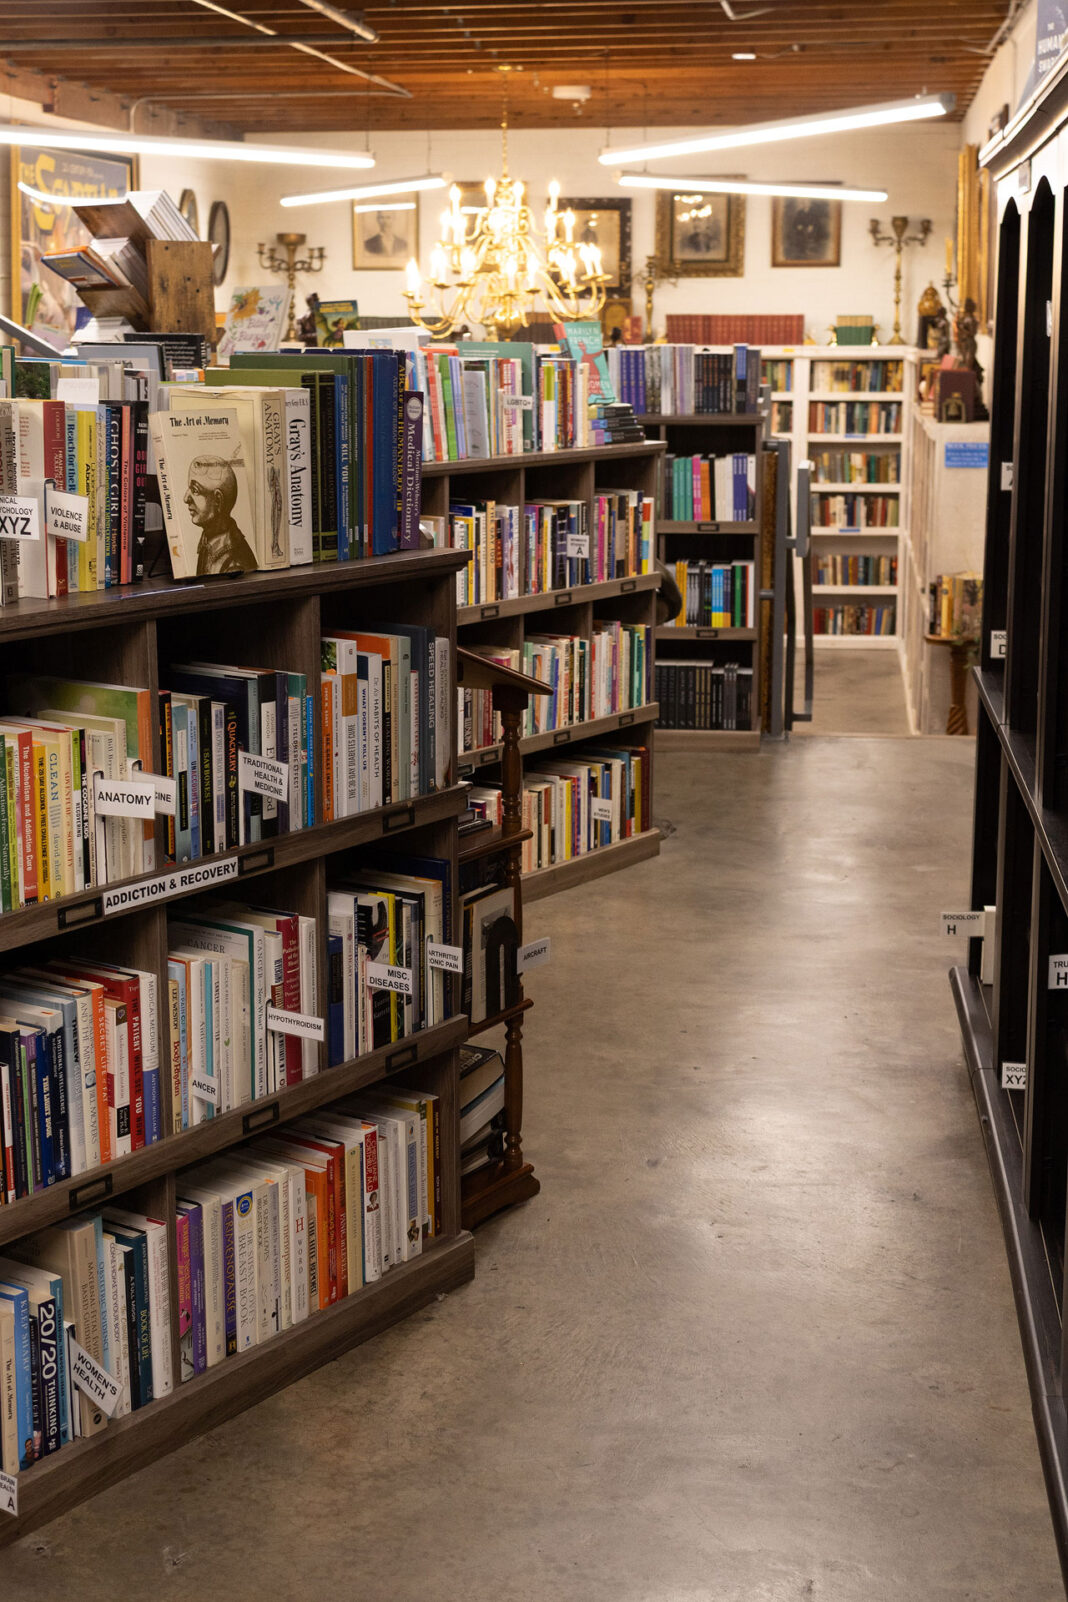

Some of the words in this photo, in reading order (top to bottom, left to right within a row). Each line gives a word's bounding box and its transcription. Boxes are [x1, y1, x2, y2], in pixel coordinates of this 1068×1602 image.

[170, 417, 182, 427] The
[183, 418, 195, 427] Art
[203, 416, 229, 427] Memory
[4, 426, 13, 440] THE
[67, 424, 75, 453] Reach
[264, 402, 274, 465] ANATOMY
[273, 412, 281, 456] GRAY'S
[286, 419, 306, 461] Gray's
[110, 420, 120, 482] GHOST
[341, 443, 349, 463] KILL
[406, 423, 416, 472] Medical
[6, 451, 16, 490] THEORY
[68, 454, 76, 468] for
[68, 468, 76, 483] the
[341, 465, 349, 483] YOU
[163, 492, 174, 520] Memory
[289, 465, 307, 528] Anatomy
[50, 507, 83, 523] VIOLENCE
[404, 476, 415, 542] Dictionary
[0, 517, 32, 536] XYZ
[53, 520, 60, 528] &
[60, 523, 82, 534] ABUSE
[576, 546, 584, 555] A
[22, 746, 31, 760] The
[228, 721, 237, 773] QUACKERY
[49, 752, 59, 801] CLEAN
[243, 756, 283, 776] TRADITIONAL
[254, 770, 278, 783] HEALTH
[23, 761, 32, 802] Alcoholism
[254, 780, 283, 797] MEDICINE
[98, 791, 152, 806] ANATOMY
[24, 803, 32, 817] and
[25, 819, 33, 853] Addiction
[53, 833, 61, 857] david
[26, 854, 34, 872] Cure
[106, 881, 165, 908] ADDICTION
[169, 879, 177, 889] &
[180, 862, 236, 887] RECOVERY
[948, 925, 957, 935] H
[523, 947, 547, 961] AIRCRAFT
[388, 969, 410, 981] MISC.
[446, 962, 458, 972] PAIN
[370, 977, 410, 991] DISEASES
[80, 1002, 89, 1023] AND
[267, 1015, 321, 1031] HYPOTHYROIDISM
[82, 1027, 90, 1045] THE
[83, 1046, 91, 1072] MIND
[42, 1075, 50, 1093] THE
[192, 1080, 215, 1095] ANCER
[43, 1094, 51, 1116] LIGHT
[89, 1106, 98, 1145] MOYERS
[281, 1180, 289, 1198] the
[159, 1235, 168, 1246] THE
[246, 1230, 254, 1246] DR.
[160, 1246, 168, 1271] CHANGE
[224, 1205, 236, 1313] PERIMENOPAUSE
[238, 1234, 247, 1284] BREAST
[281, 1224, 291, 1284] menopause
[247, 1251, 255, 1284] SUSAN
[160, 1272, 169, 1293] BEFORE
[309, 1262, 317, 1296] REPORT
[161, 1293, 169, 1305] THE
[239, 1289, 249, 1329] BOOK
[247, 1288, 256, 1324] LOVE'S
[20, 1300, 29, 1328] KEEP
[140, 1309, 148, 1333] BOOK
[162, 1305, 170, 1328] CHANGE
[39, 1303, 57, 1380] 20/20
[142, 1334, 149, 1344] OF
[21, 1333, 30, 1372] SHARP
[73, 1363, 106, 1401] HEALTH
[77, 1352, 117, 1396] WOMEN'S
[47, 1379, 58, 1436] THINKING
[8, 1497, 15, 1511] A
